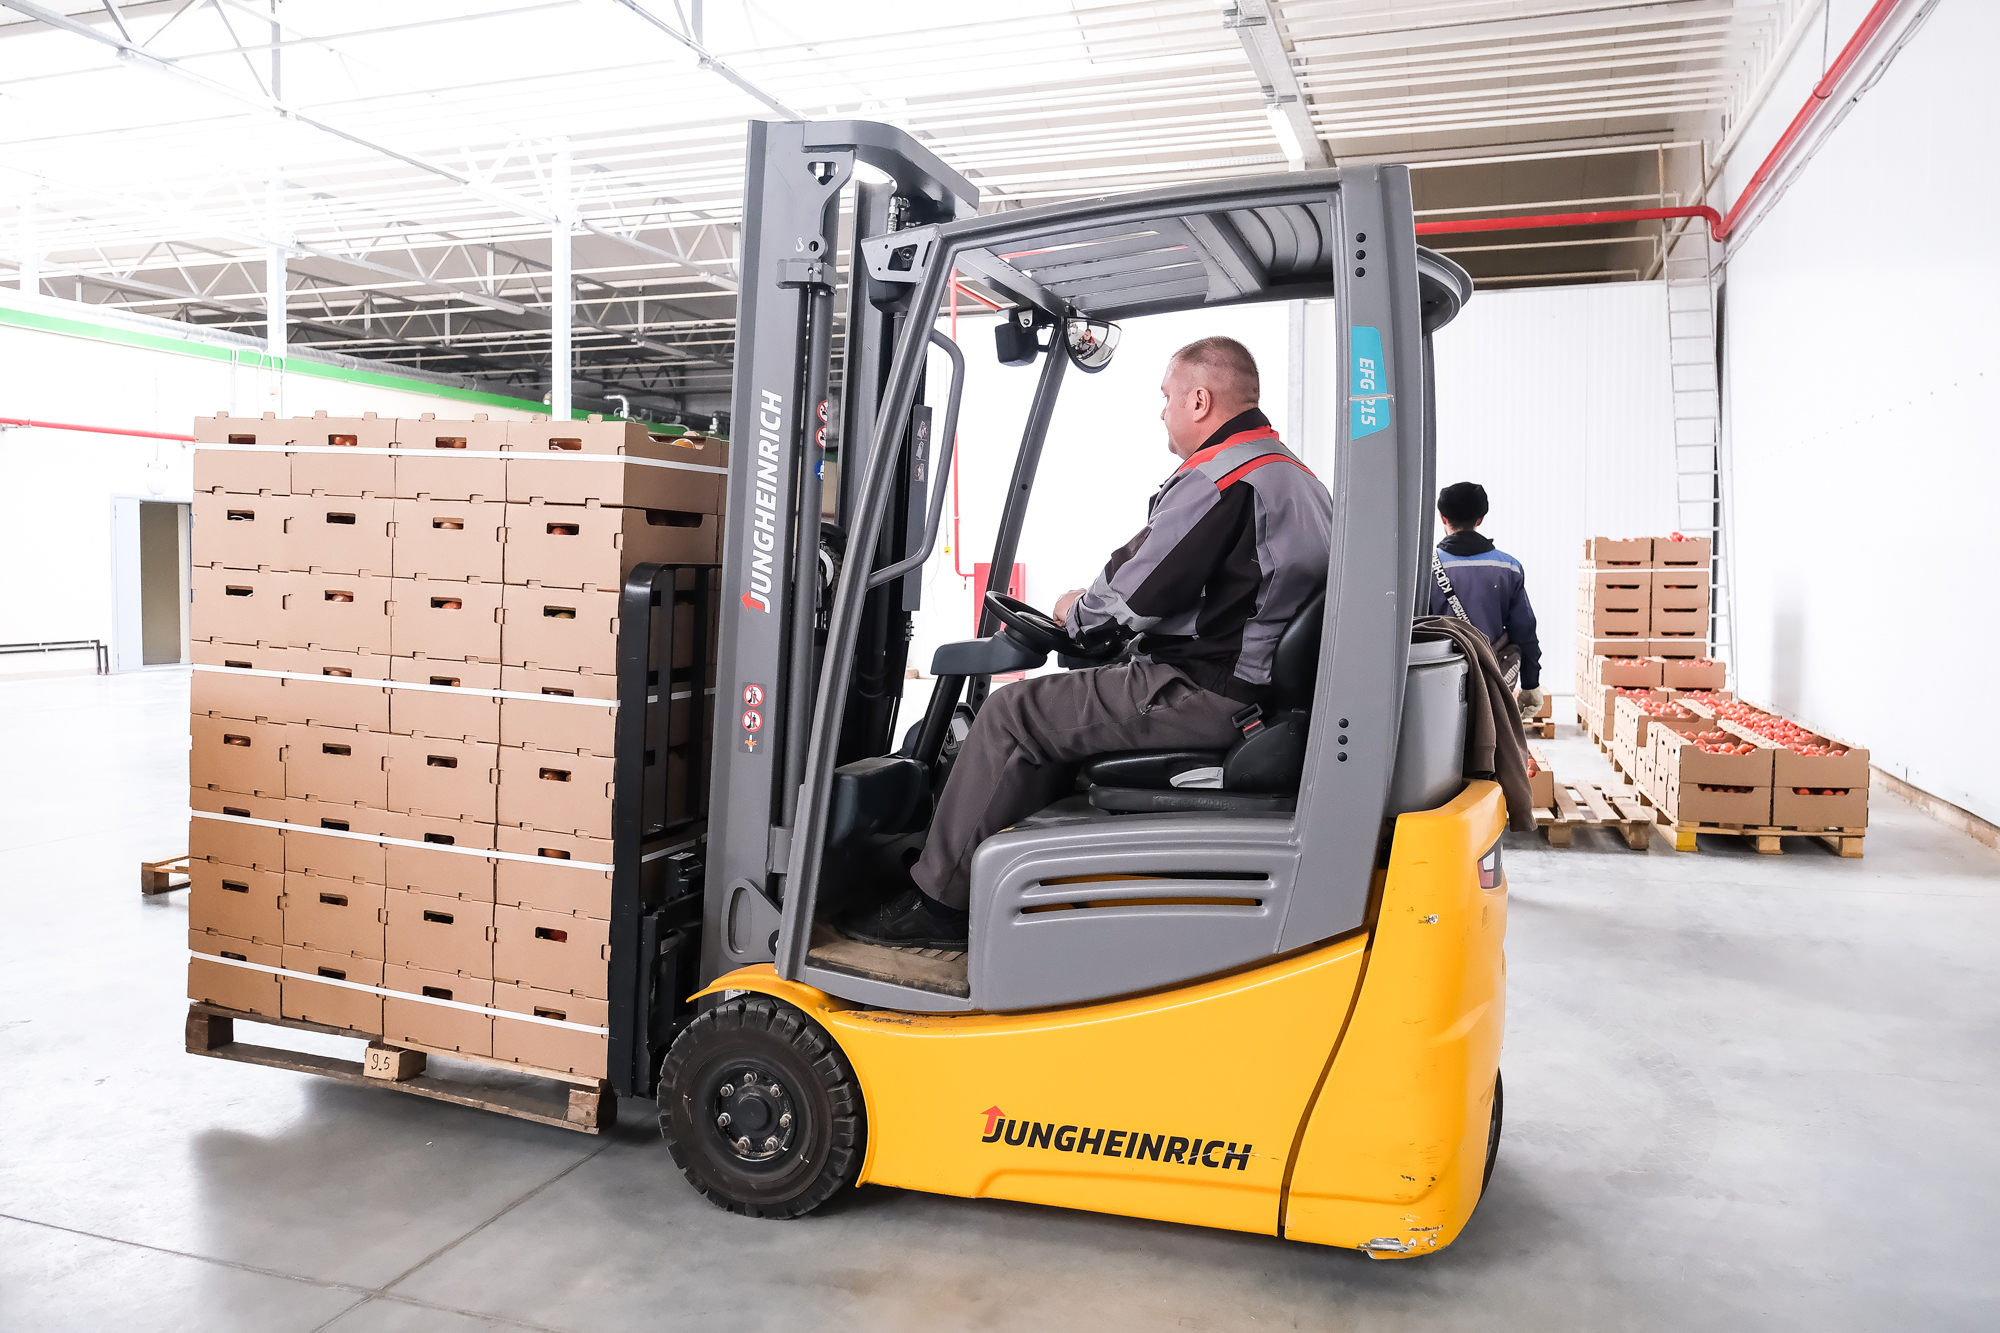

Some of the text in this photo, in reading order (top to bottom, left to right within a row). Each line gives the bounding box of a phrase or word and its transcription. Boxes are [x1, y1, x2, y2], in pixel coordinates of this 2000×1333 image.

[1360, 357, 1375, 390] EFG
[750, 388, 783, 614] JUNGHEINRICH
[371, 1053, 390, 1071] 9.5
[982, 1118, 1253, 1171] JUNGHEINRICH
